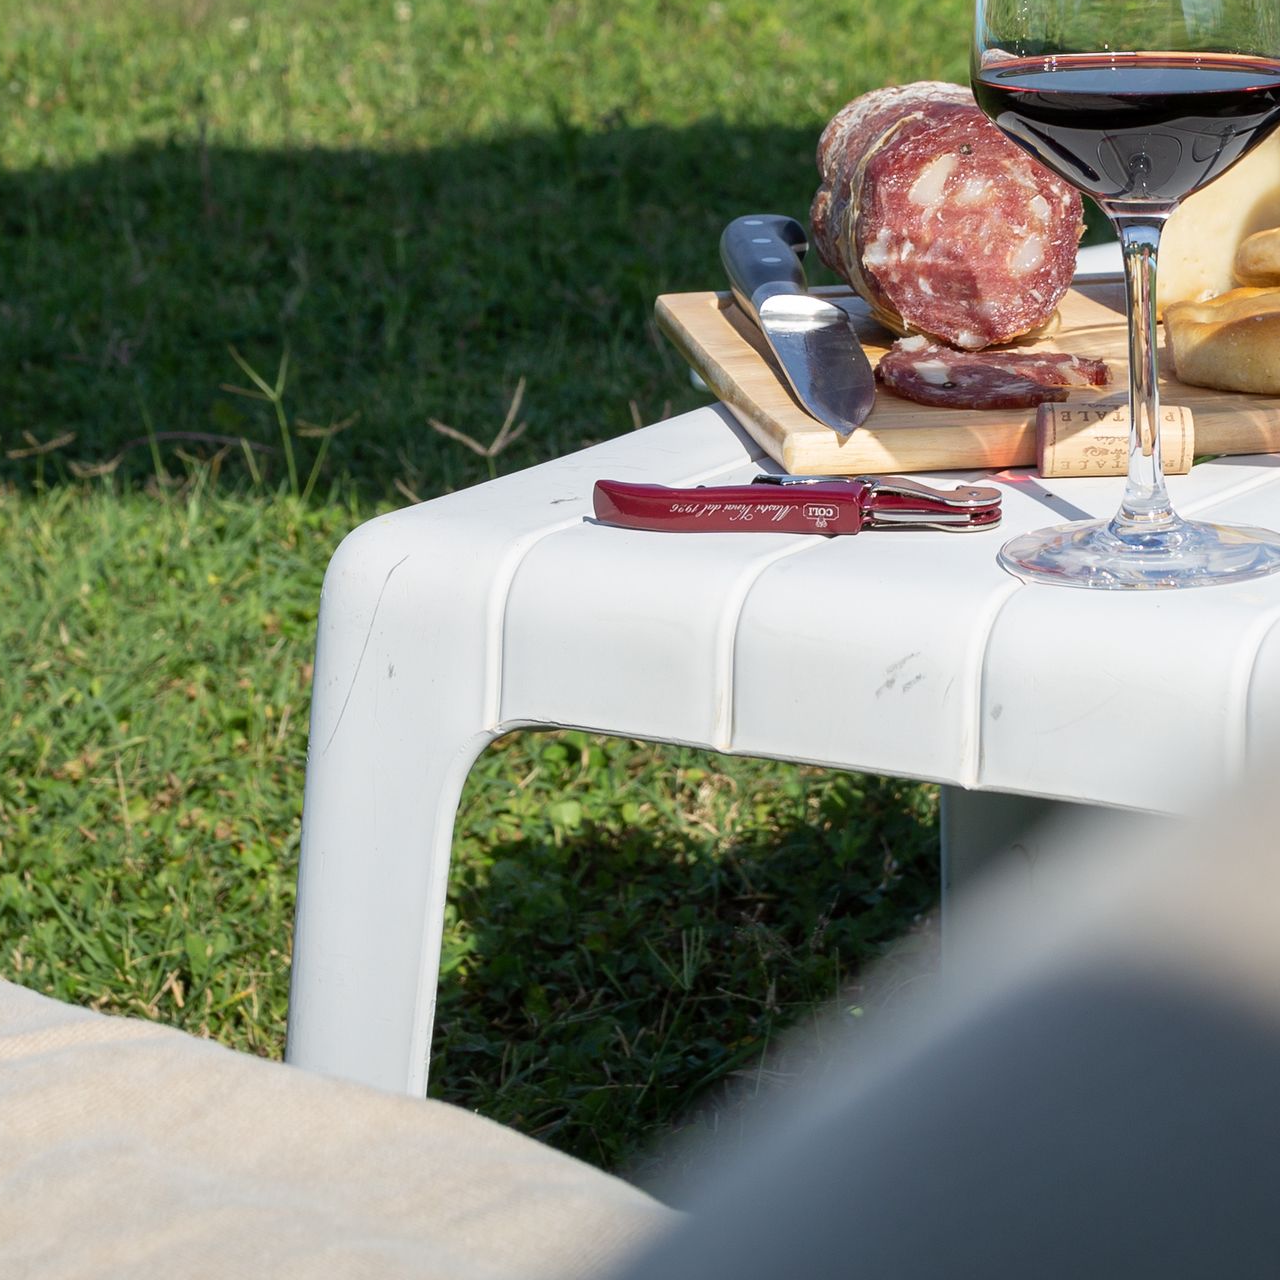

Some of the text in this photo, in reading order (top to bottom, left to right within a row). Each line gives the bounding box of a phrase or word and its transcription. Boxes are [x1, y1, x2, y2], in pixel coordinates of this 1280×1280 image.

[1061, 410, 1176, 422] PTALE
[1060, 458, 1176, 470] PTALE
[695, 503, 721, 518] dal
[808, 506, 833, 517] COLI
